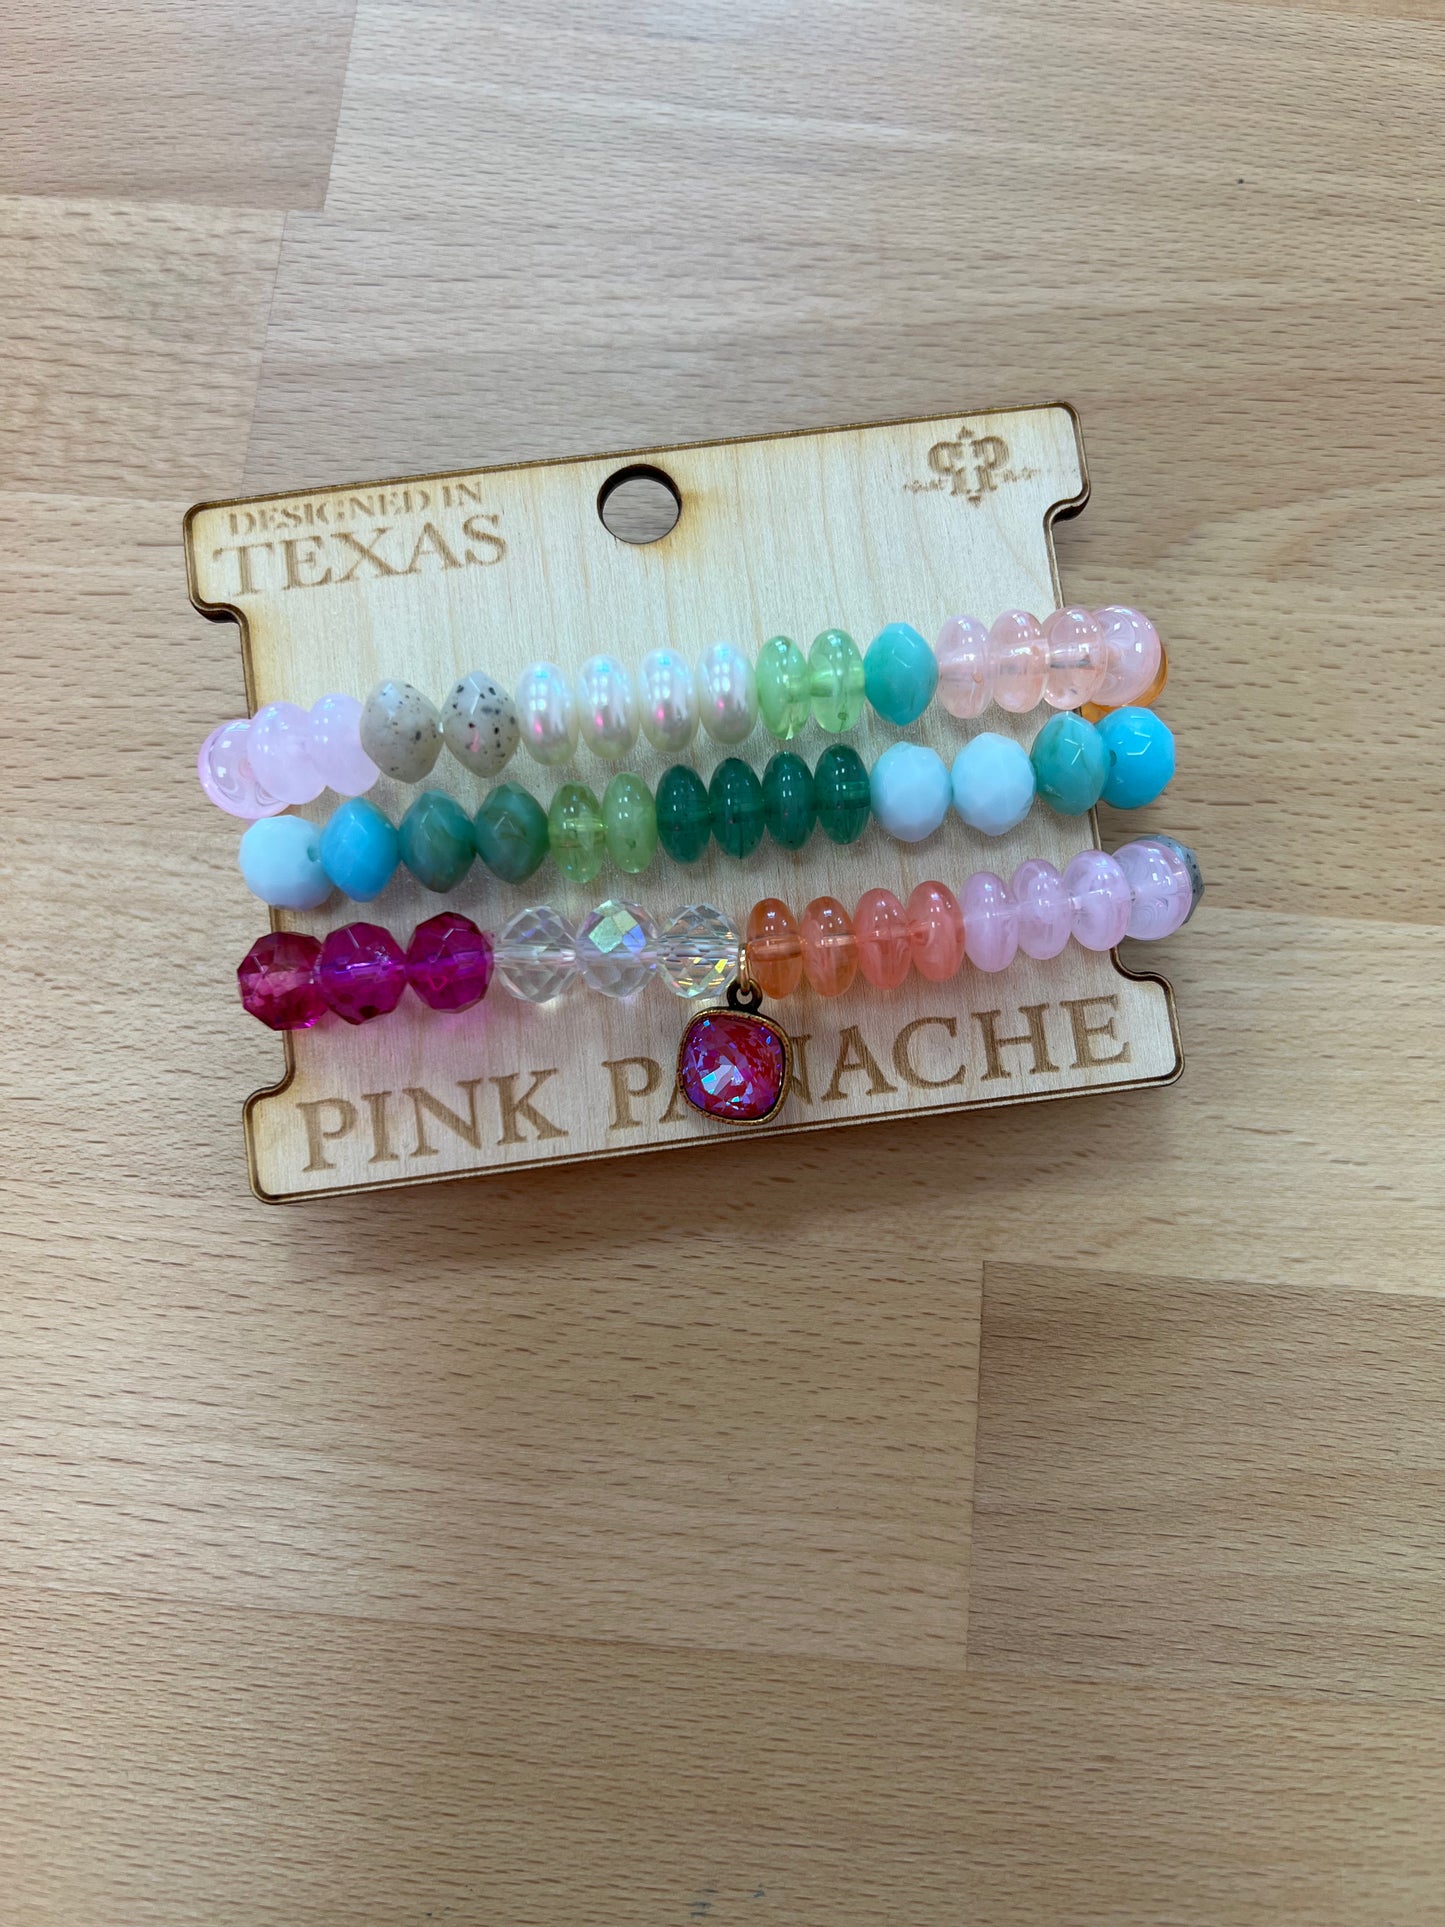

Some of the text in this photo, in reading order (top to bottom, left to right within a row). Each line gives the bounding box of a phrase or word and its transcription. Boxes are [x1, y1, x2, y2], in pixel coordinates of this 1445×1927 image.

[229, 481, 483, 536] DESIGNED IN
[213, 514, 509, 596] TEXAS
[296, 1069, 569, 1173] PINK
